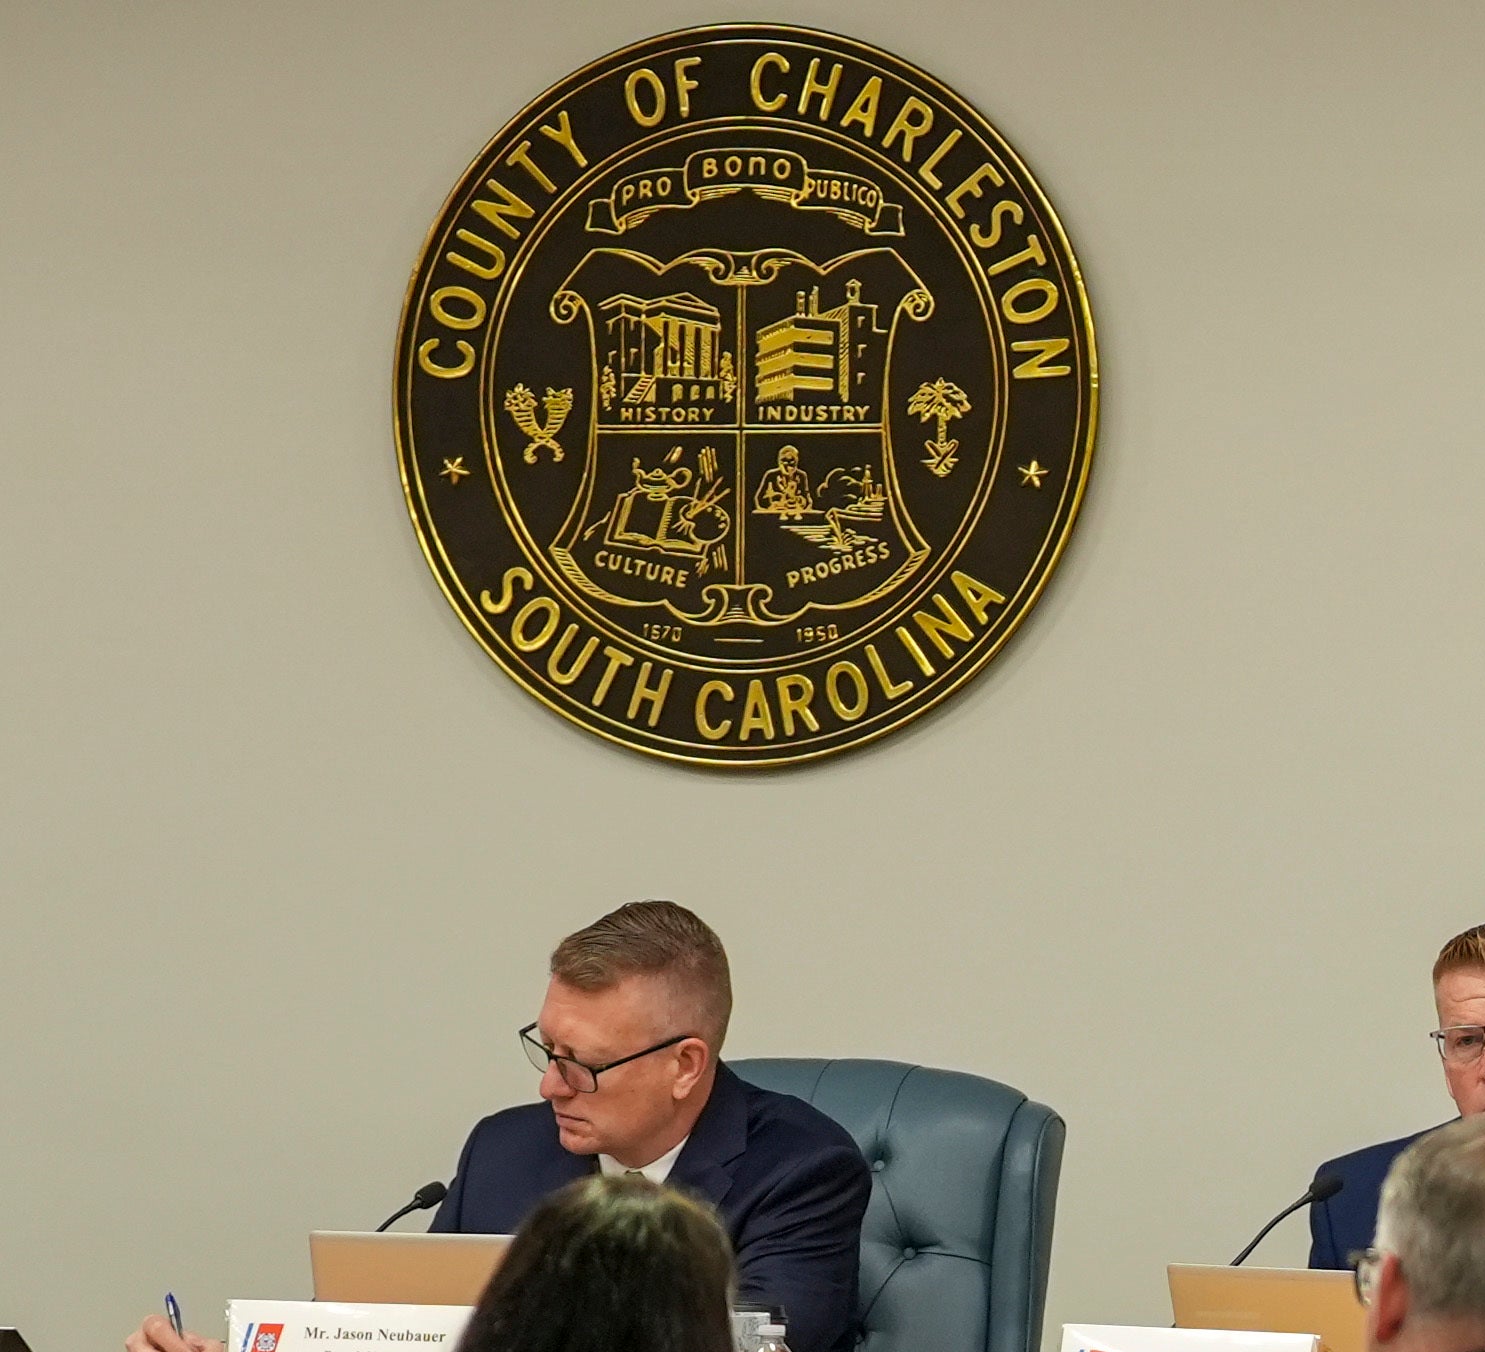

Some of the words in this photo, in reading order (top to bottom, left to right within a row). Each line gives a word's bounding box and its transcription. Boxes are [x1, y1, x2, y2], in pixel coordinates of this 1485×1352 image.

[622, 176, 671, 206] PRO
[804, 176, 878, 208] PUBLICO
[419, 110, 590, 380] COUNTY
[624, 55, 703, 128] OF
[749, 51, 1072, 381] CHARLESTON
[619, 405, 714, 424] HISTORY
[757, 404, 870, 424] INDUSTRY
[594, 550, 690, 589] CULTURE
[785, 541, 891, 589] PROGRESS
[479, 566, 675, 725] SOUTH
[695, 569, 1007, 742] CAROLINA
[304, 1327, 330, 1340] Mr.
[334, 1327, 373, 1341] Jason
[377, 1328, 446, 1343] Neubauer
